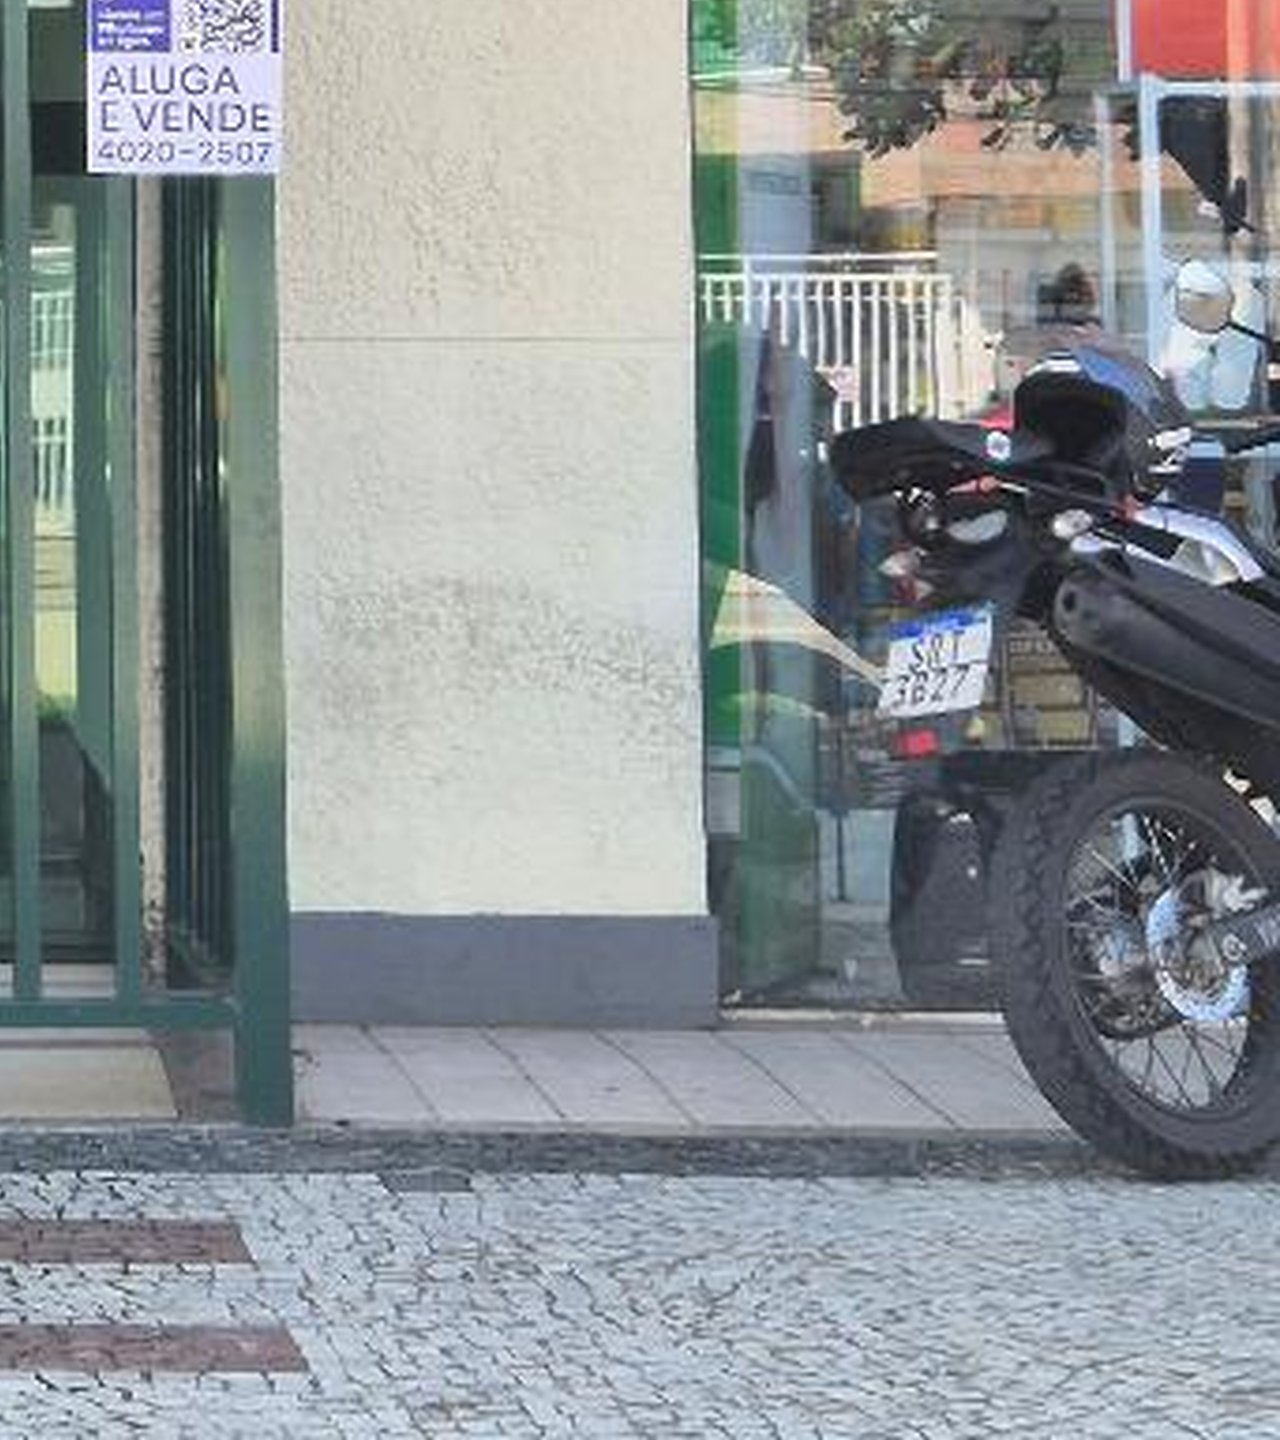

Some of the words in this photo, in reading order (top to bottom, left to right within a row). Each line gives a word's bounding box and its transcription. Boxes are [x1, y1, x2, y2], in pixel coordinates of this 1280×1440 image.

[98, 64, 240, 95] ALUGA
[101, 102, 120, 132] E
[133, 102, 271, 132] VENDE
[97, 141, 273, 164] 4020-2507
